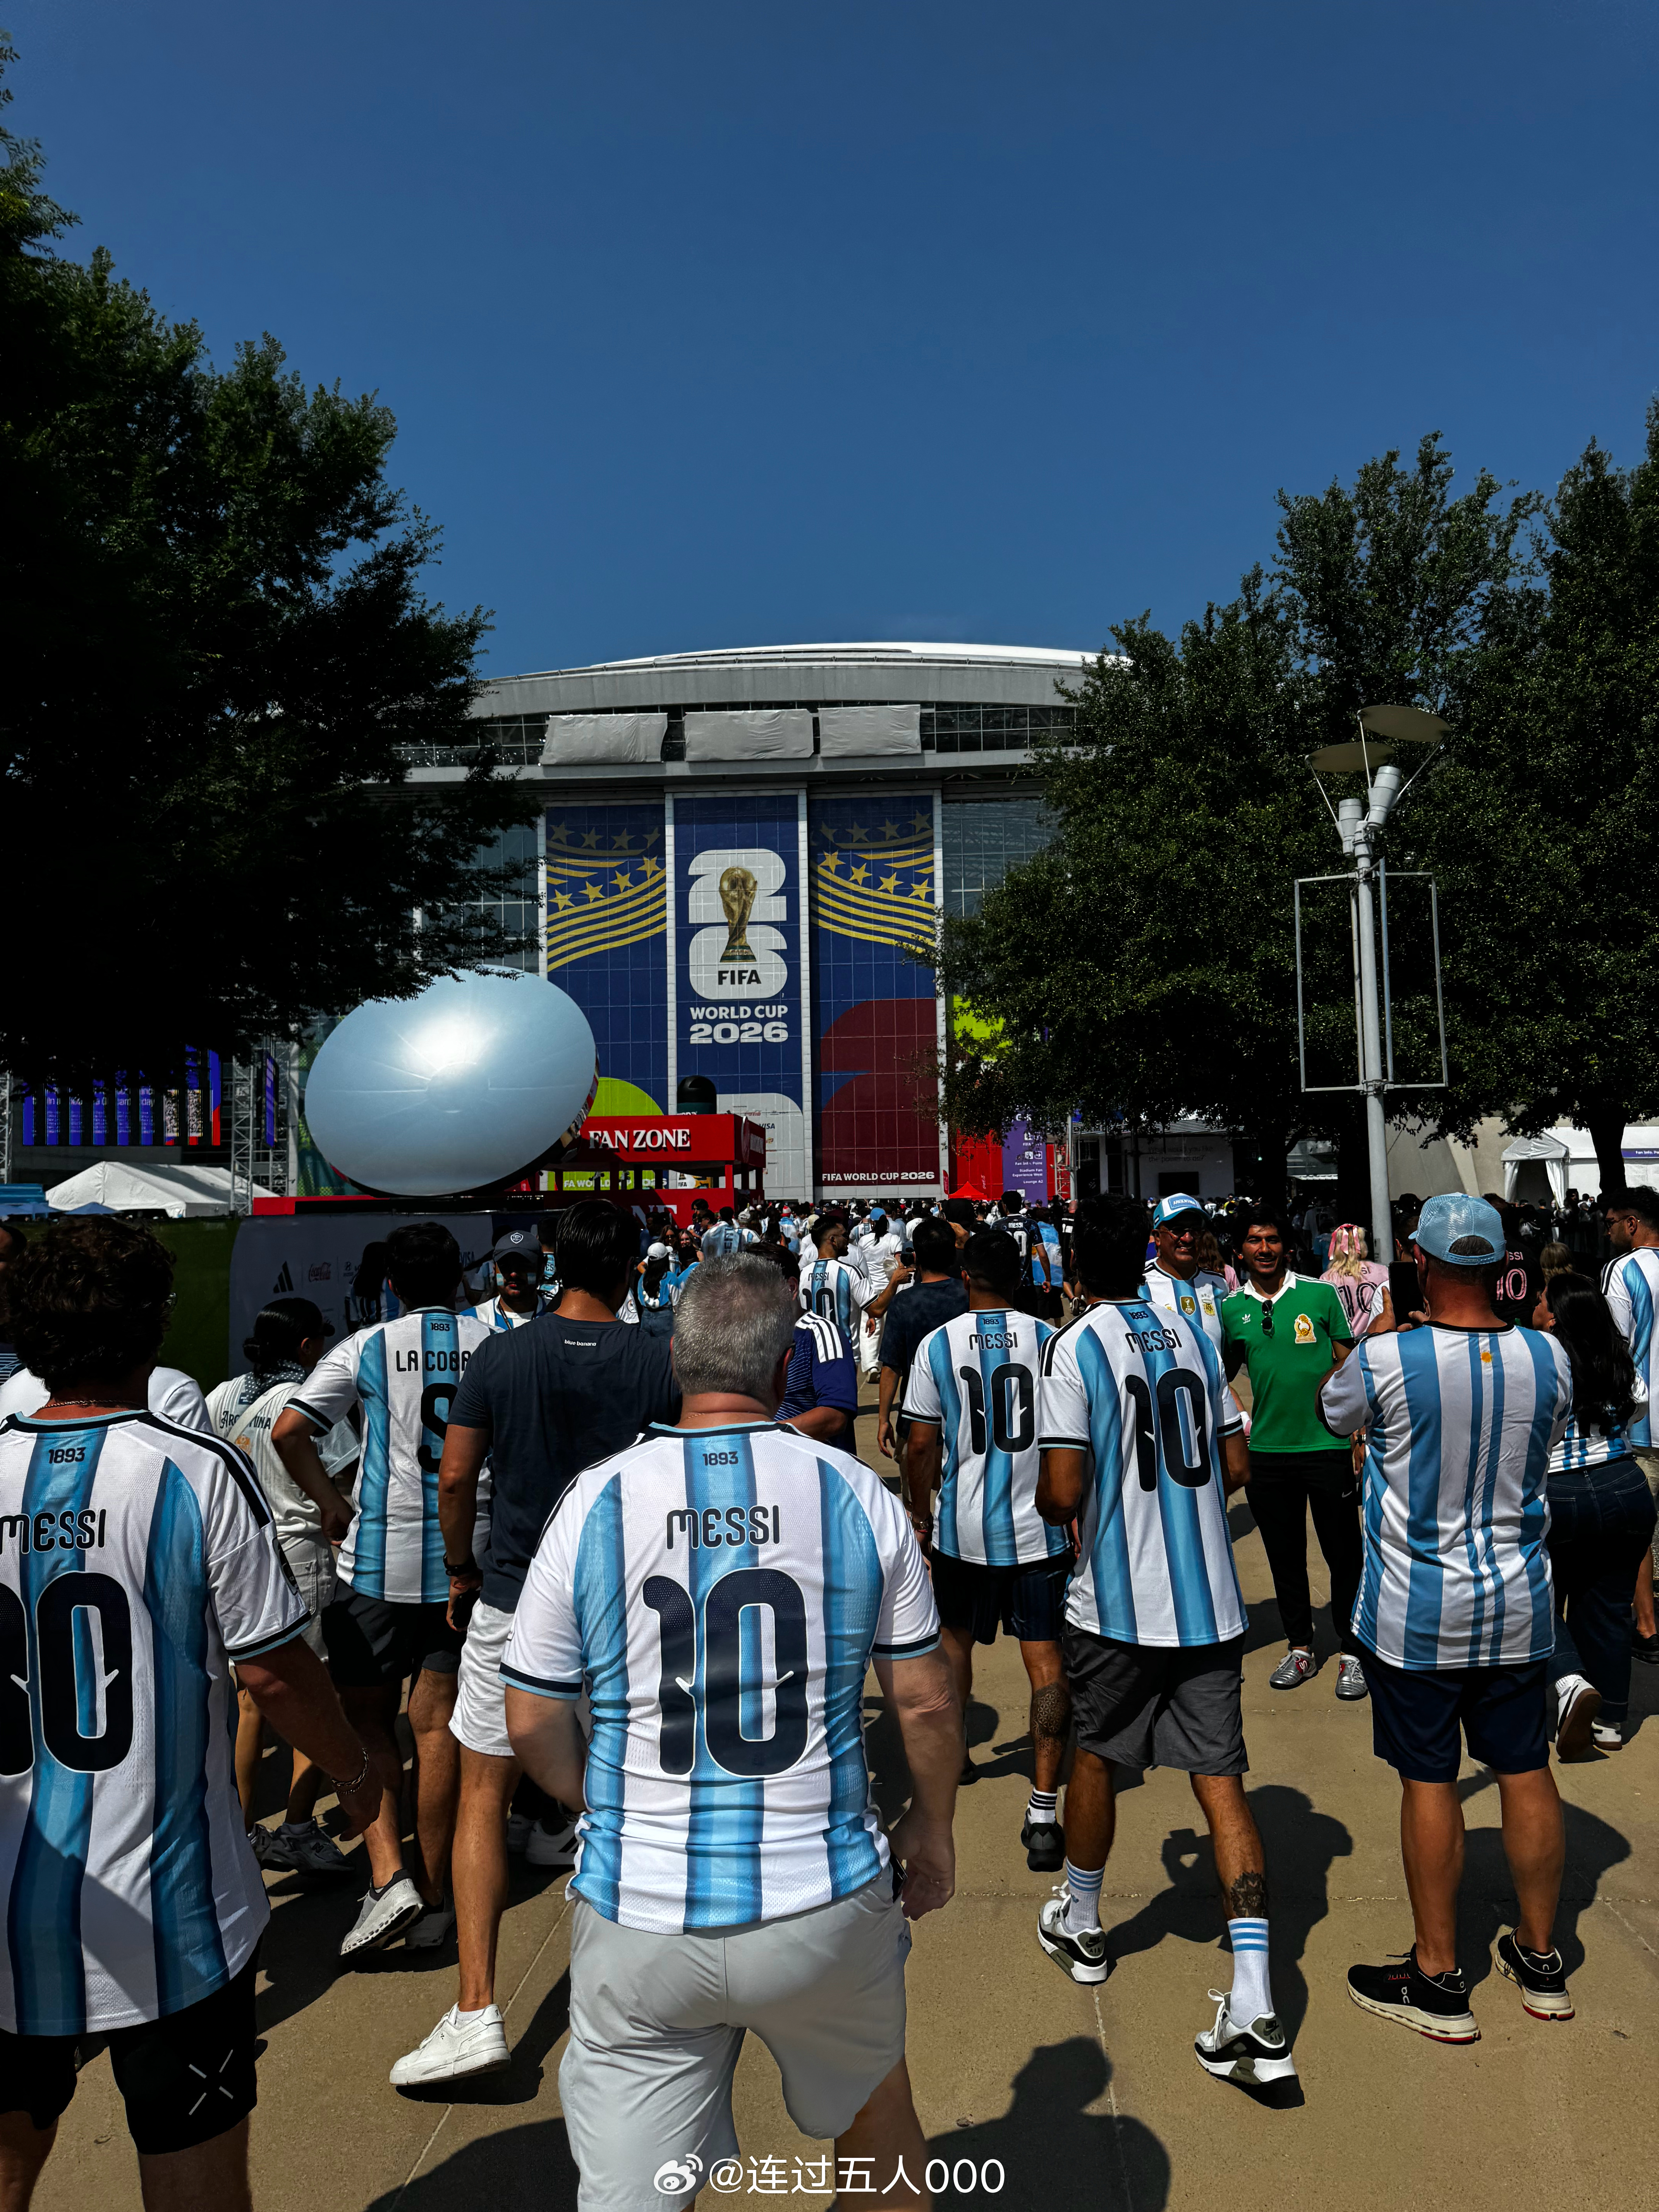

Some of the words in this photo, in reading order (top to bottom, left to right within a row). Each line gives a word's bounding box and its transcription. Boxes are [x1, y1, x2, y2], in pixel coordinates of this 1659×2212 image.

[718, 970, 761, 985] FIFA
[690, 1006, 751, 1020] WORLD
[754, 1005, 788, 1018] CUP
[690, 1021, 788, 1044] 2026
[589, 1130, 629, 1149] FAN
[633, 1128, 690, 1149] ZONE
[577, 1179, 610, 1188] WOLD
[843, 1173, 878, 1181] WORLD
[879, 1172, 899, 1180] CUP
[901, 1171, 935, 1180] 2026
[1509, 1252, 1523, 1260] SSI
[808, 1272, 829, 1281] MESSI
[1496, 1268, 1527, 1300] 10
[1128, 1311, 1149, 1319] 1893
[431, 1322, 450, 1331] 1893
[969, 1332, 1018, 1350] MESSI
[1124, 1328, 1183, 1353] MESSI
[396, 1350, 418, 1372] LA
[959, 1362, 1035, 1455] 10
[1124, 1367, 1211, 1492] 10
[48, 1447, 86, 1464] 1893
[702, 1451, 739, 1466] 1893
[0, 1508, 107, 1555] MESSI
[666, 1504, 780, 1550] MESSI
[0, 1570, 134, 1776] 10
[642, 1567, 809, 1778] 10
